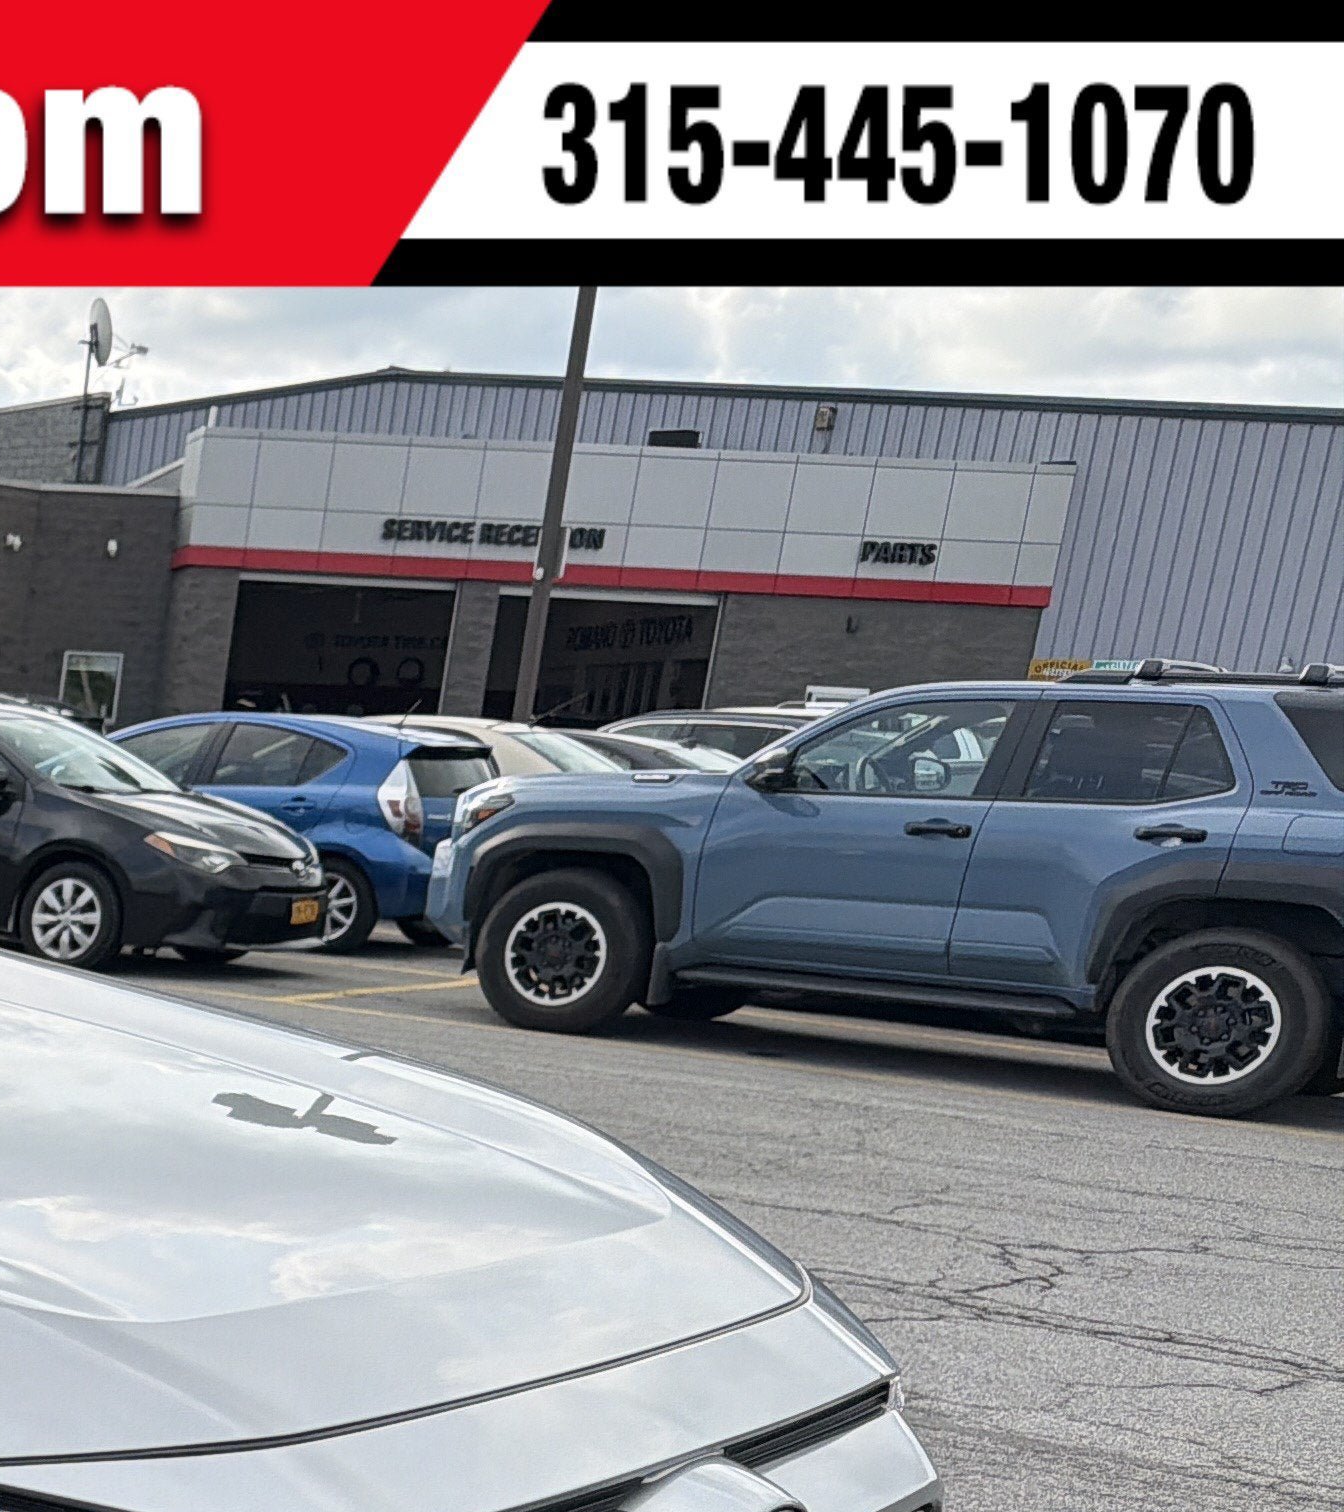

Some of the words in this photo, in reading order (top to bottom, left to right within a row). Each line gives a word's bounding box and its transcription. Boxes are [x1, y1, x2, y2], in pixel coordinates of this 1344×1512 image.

[382, 518, 475, 544] SERVICE
[479, 522, 606, 550] RECEON
[860, 541, 938, 566] PARTS
[639, 615, 692, 645] TOYOTA
